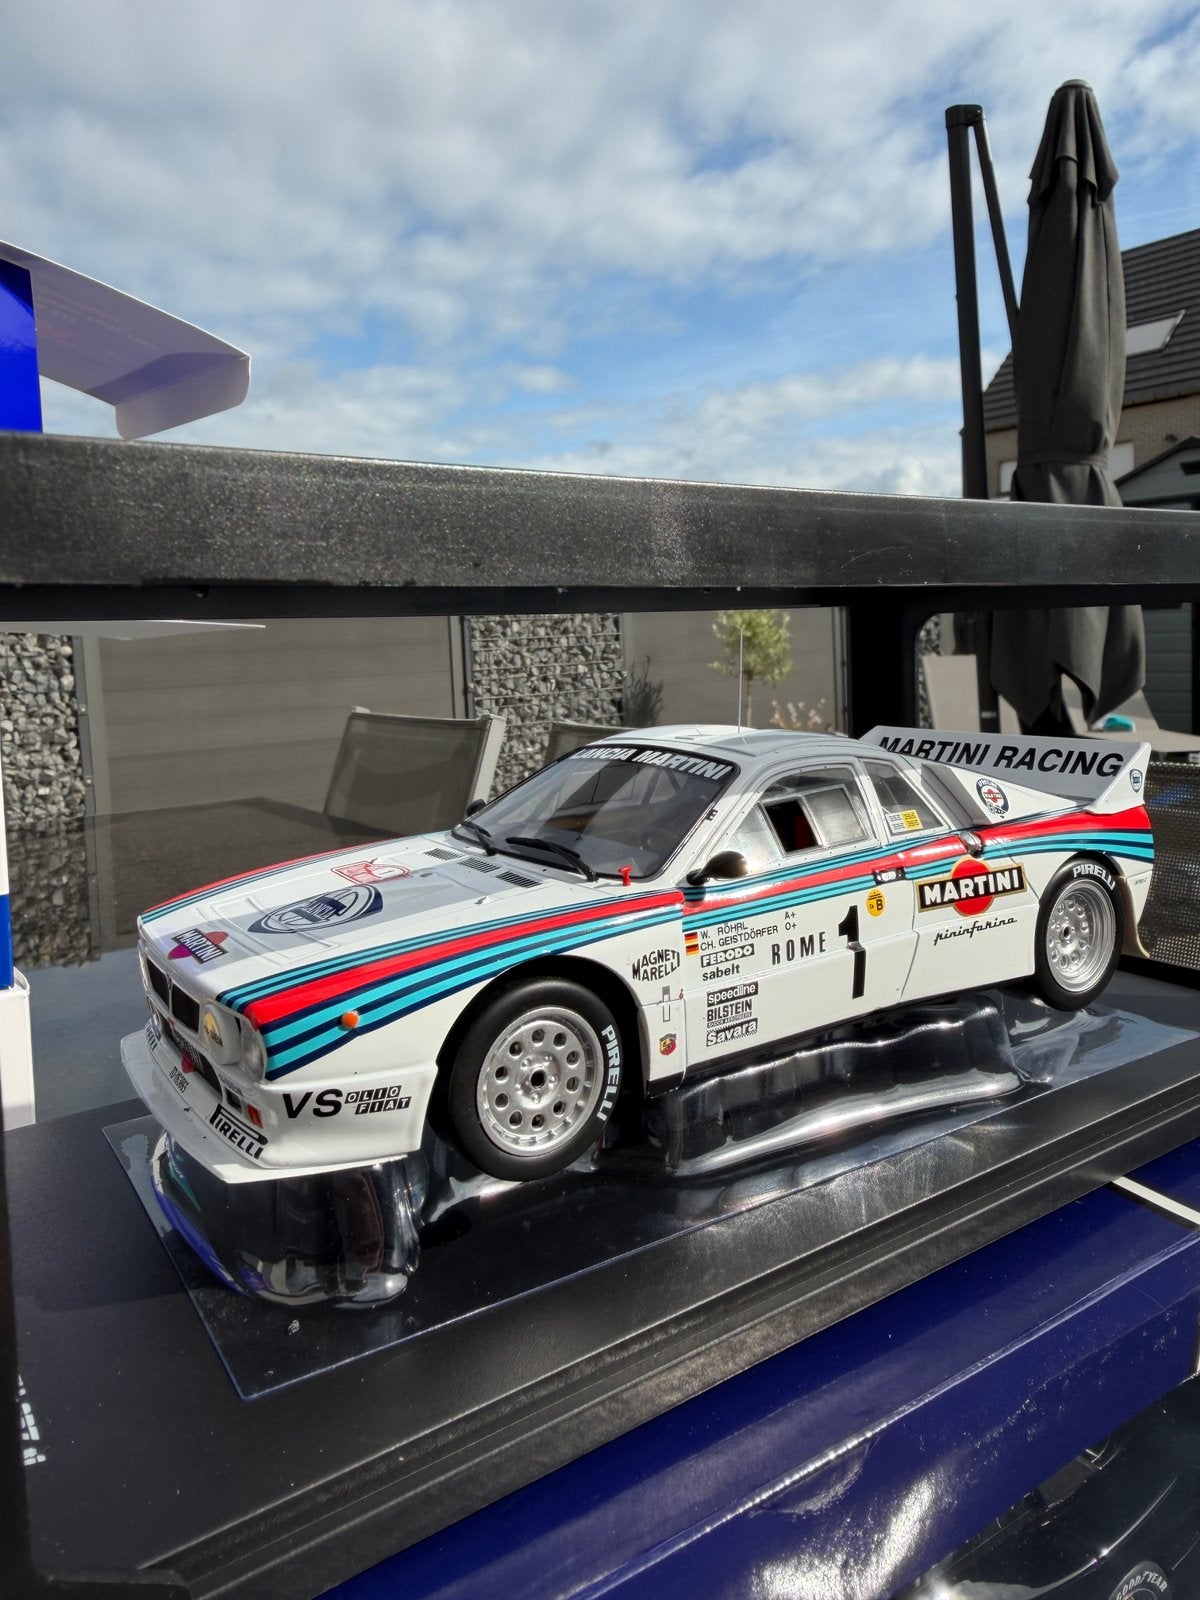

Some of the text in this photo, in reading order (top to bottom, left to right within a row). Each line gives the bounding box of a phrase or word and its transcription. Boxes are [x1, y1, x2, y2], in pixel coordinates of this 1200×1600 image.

[632, 751, 733, 780] MARTINI
[878, 736, 1124, 777] MARTINI RACING
[923, 869, 1019, 905] MARTINI
[1073, 864, 1116, 891] PIRELLI
[784, 911, 796, 920] A+
[700, 921, 748, 940] W. RÖHRL
[700, 925, 779, 951] CH. GEISTDÖRFER
[933, 917, 1018, 946] pininfarina
[175, 929, 223, 962] MARTINI
[702, 945, 754, 967] FERODO
[771, 931, 826, 966] ROME
[838, 905, 867, 1000] 1
[702, 964, 741, 981] sabelt
[707, 984, 756, 1004] speedline
[707, 999, 752, 1022] BILSTEIN
[707, 1020, 757, 1046] Savara
[597, 1024, 620, 1121] PIRELLI
[282, 1088, 342, 1119] VS
[346, 1086, 400, 1103] OLIO
[356, 1096, 411, 1115] FIAT
[209, 1103, 268, 1160] PIRELLI
